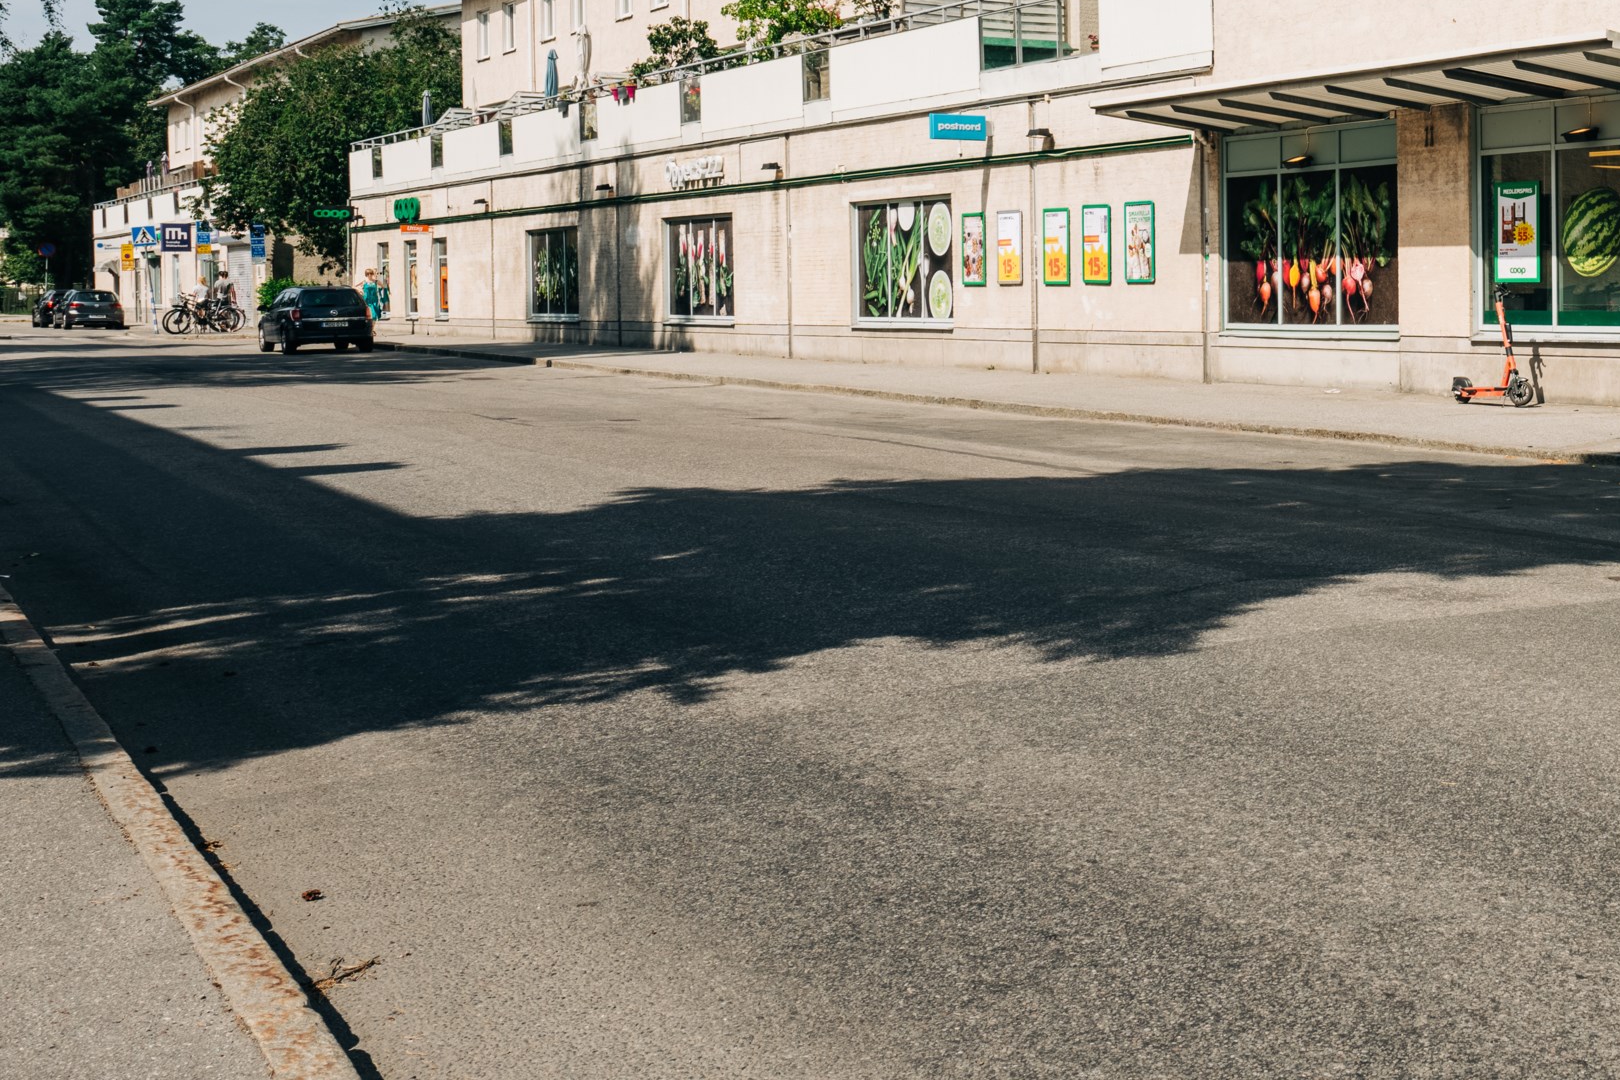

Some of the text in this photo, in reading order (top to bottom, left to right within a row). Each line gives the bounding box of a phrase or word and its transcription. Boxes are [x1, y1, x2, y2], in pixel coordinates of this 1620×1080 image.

[938, 122, 981, 131] postnord
[313, 209, 350, 219] coop
[1509, 267, 1526, 275] coop
